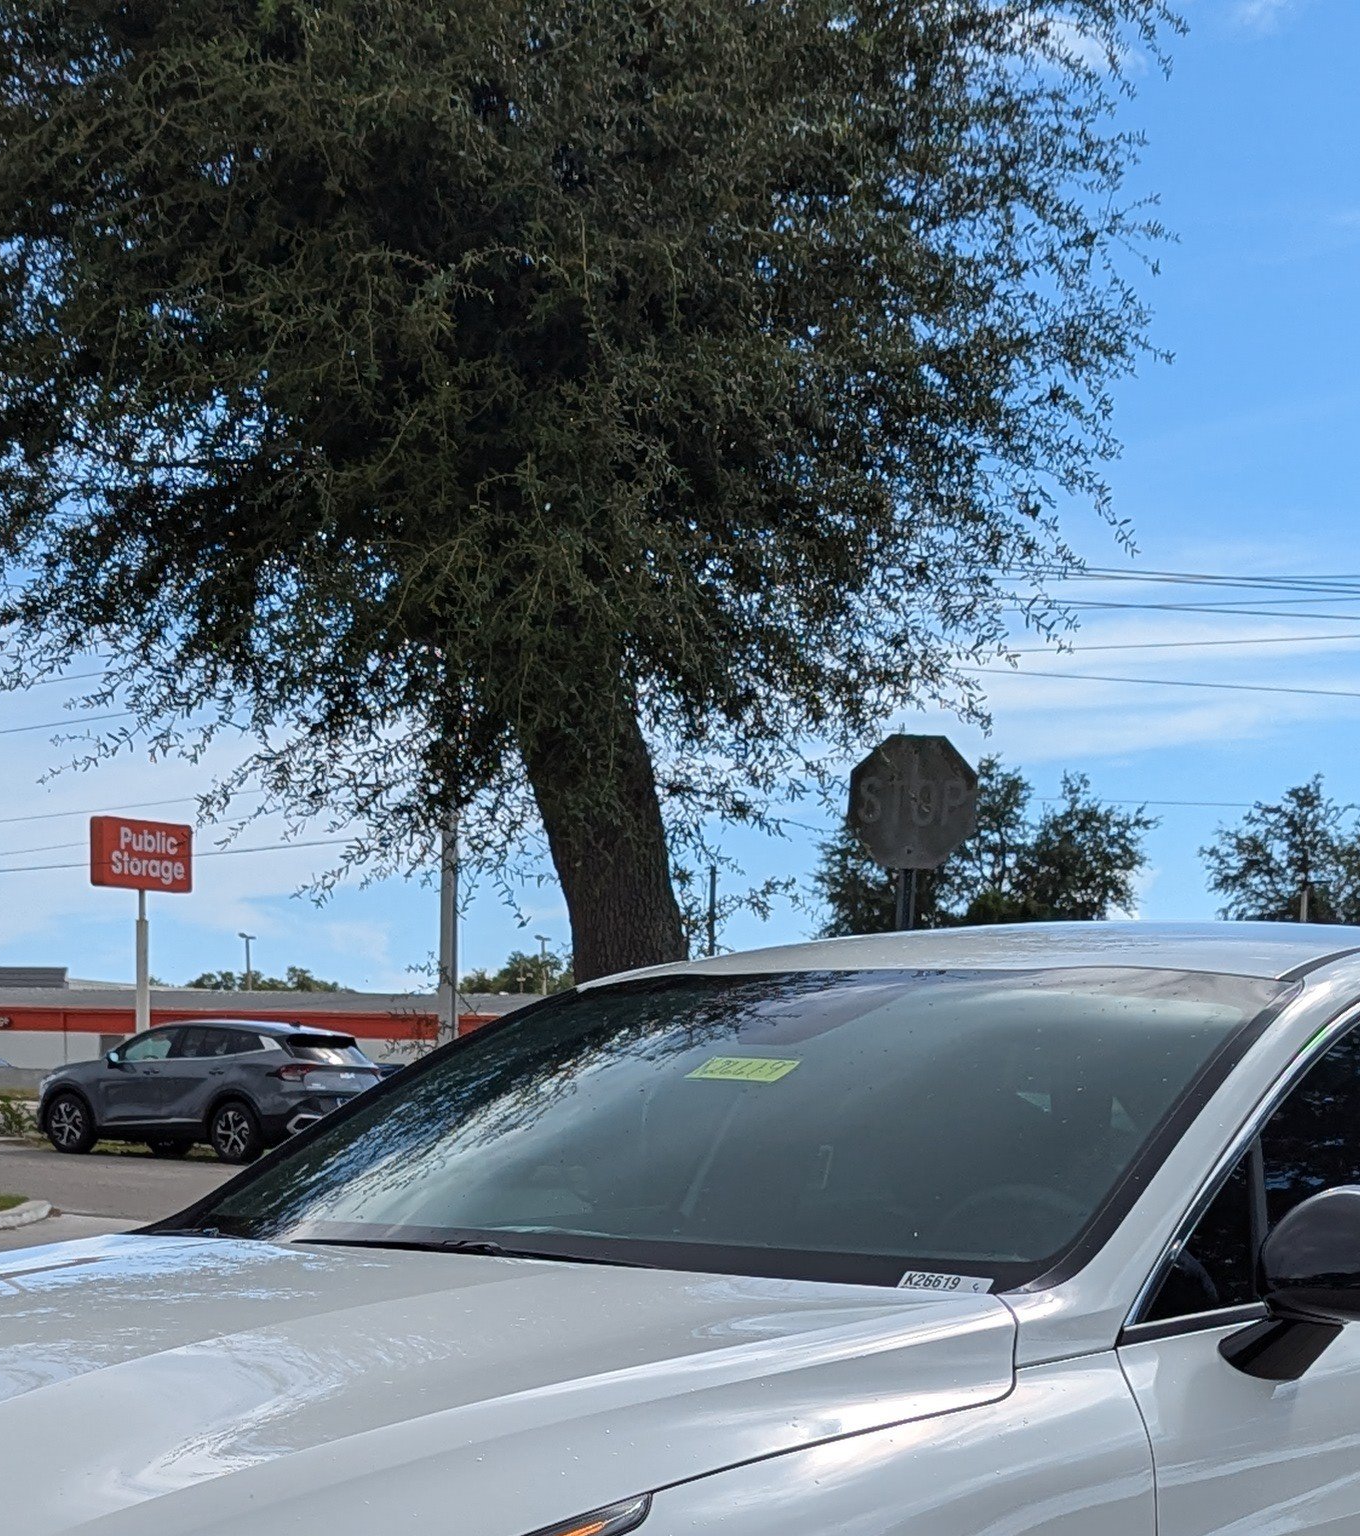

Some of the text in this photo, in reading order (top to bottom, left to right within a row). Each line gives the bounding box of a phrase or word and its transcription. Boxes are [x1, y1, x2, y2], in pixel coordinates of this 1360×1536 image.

[859, 777, 967, 826] STOP
[120, 826, 179, 855] Public
[111, 850, 185, 885] Storage
[904, 1273, 961, 1290] K26619
